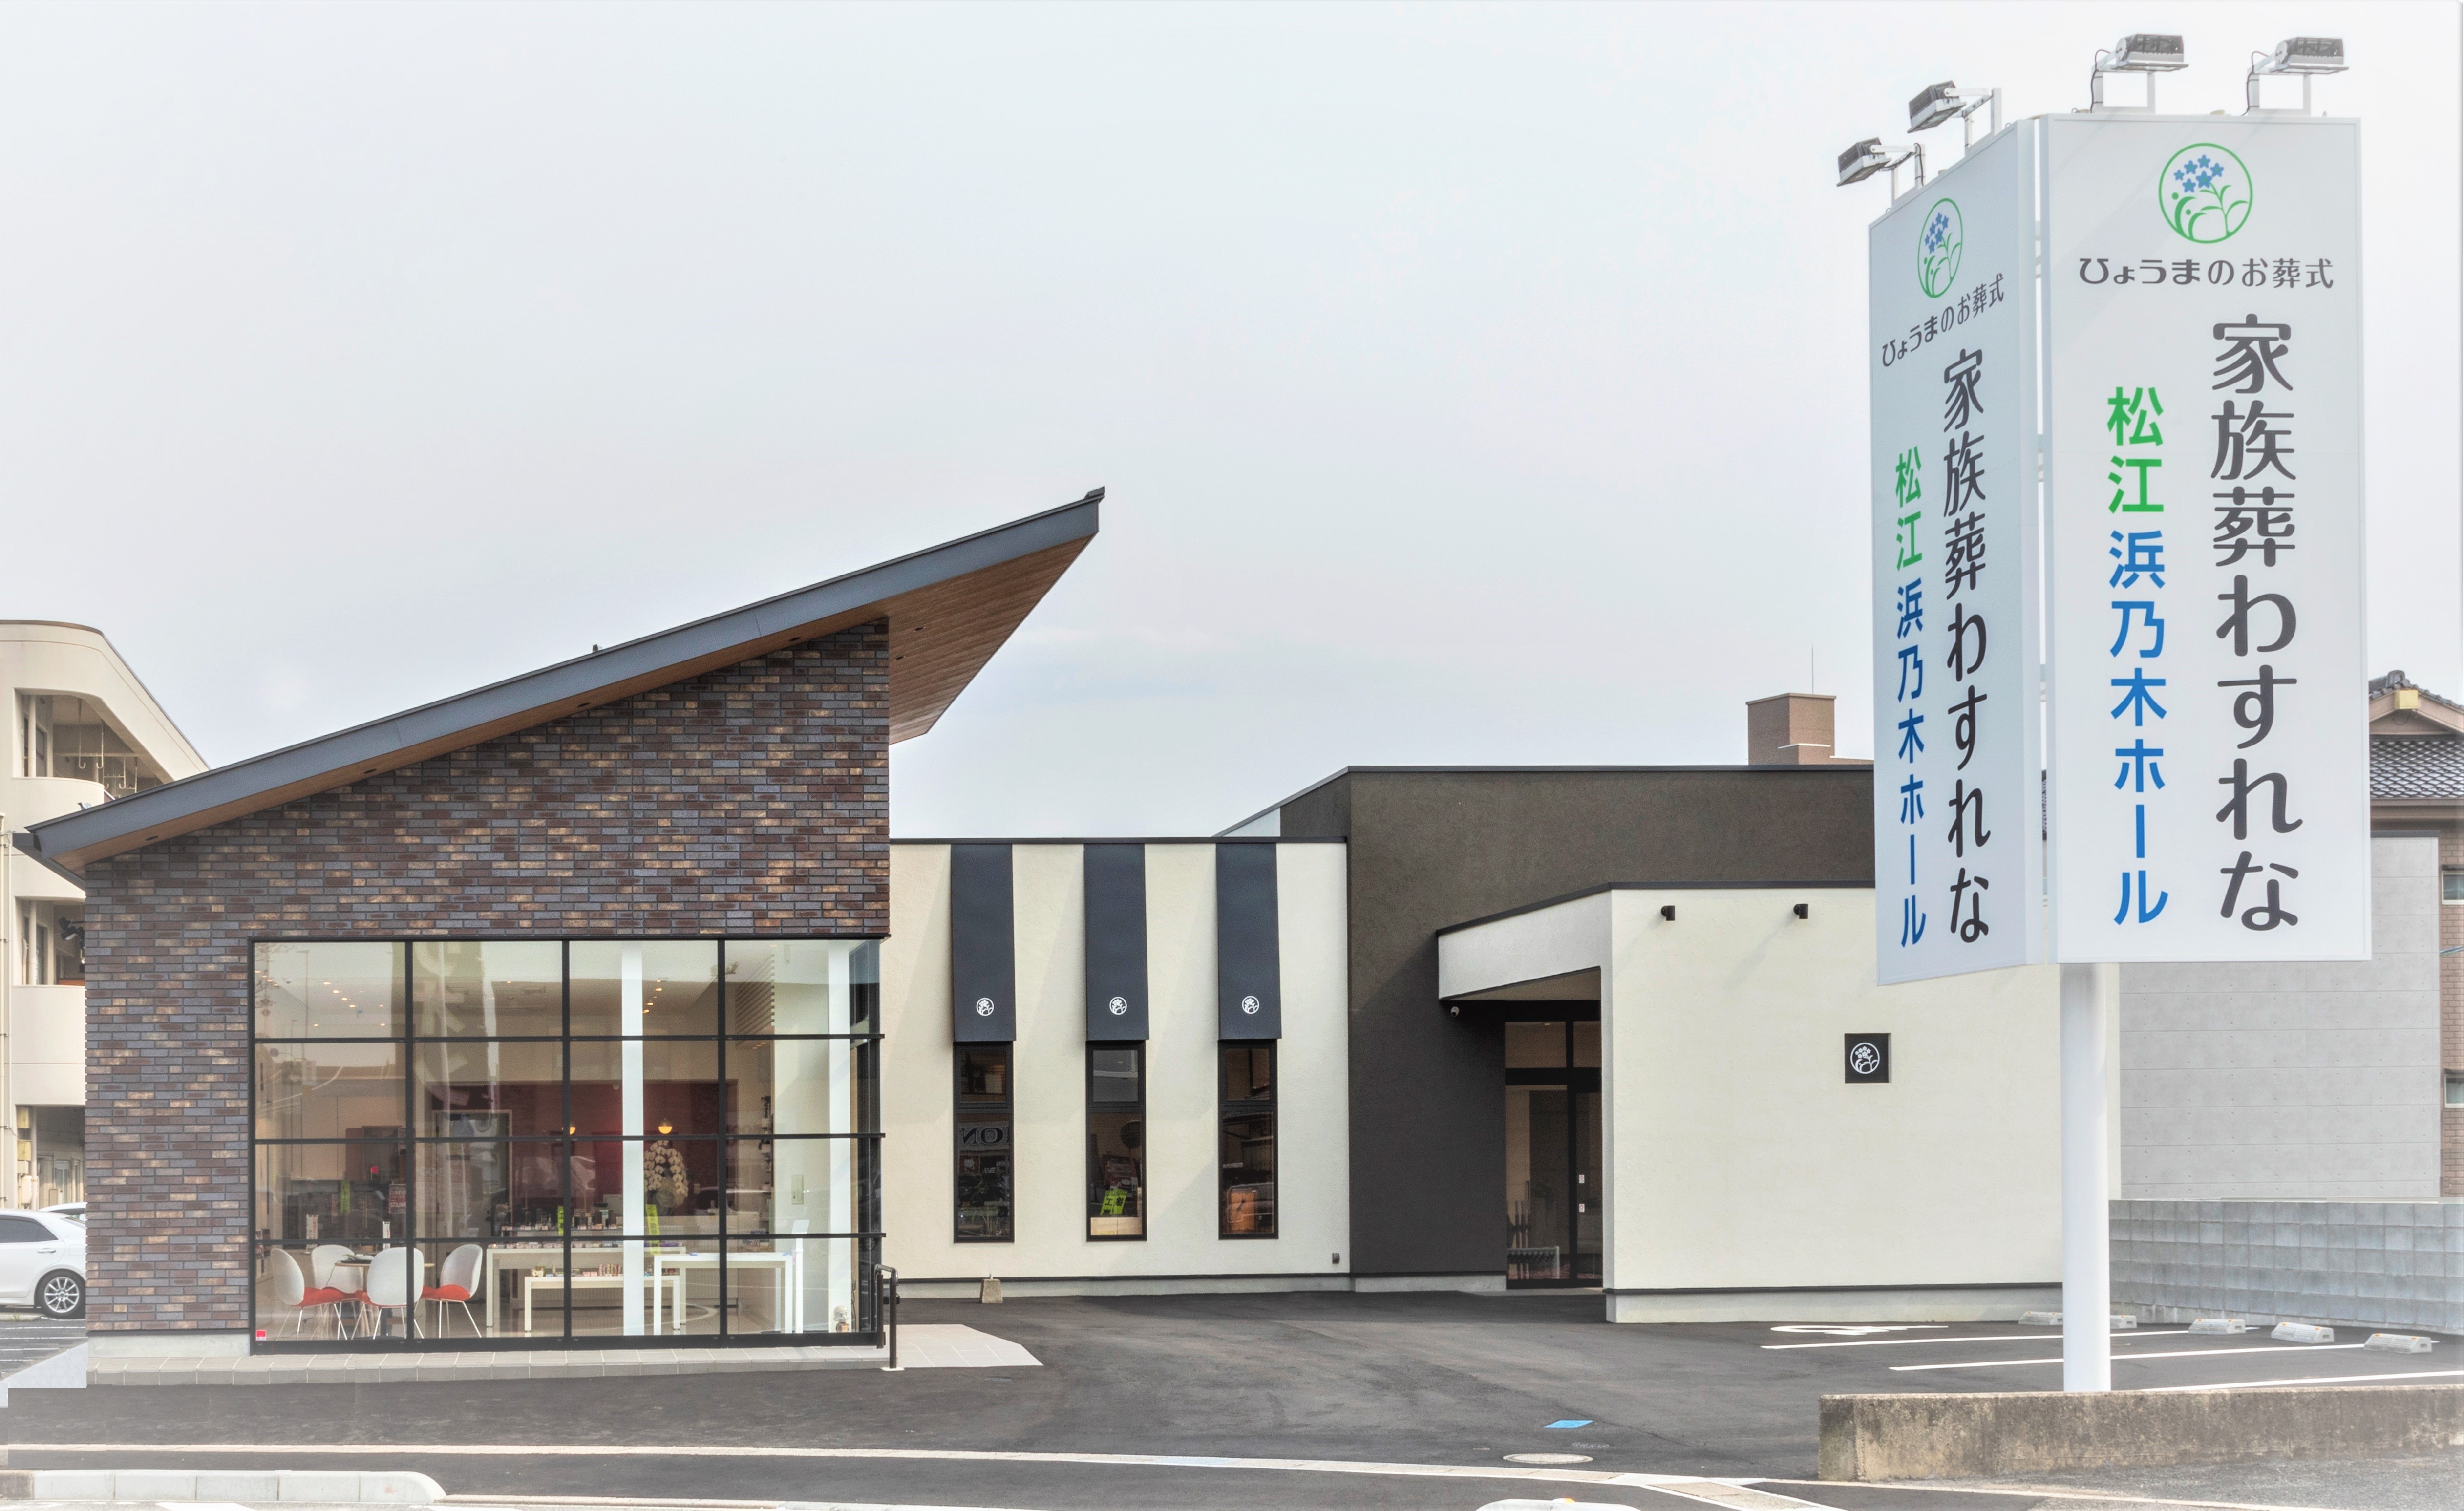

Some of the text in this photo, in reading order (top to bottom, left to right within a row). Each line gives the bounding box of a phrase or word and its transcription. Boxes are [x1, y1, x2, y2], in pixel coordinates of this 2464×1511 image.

[1882, 273, 2005, 367] ひょうまのお葬式
[2079, 257, 2334, 289] ひょうまのお葬式
[1895, 446, 1927, 948] 松江浜乃木ホール
[1943, 348, 1992, 944] 家族葬わすれな
[2106, 386, 2169, 926] 松江浜乃木ホール
[2210, 313, 2303, 932] 家族葬わすれな
